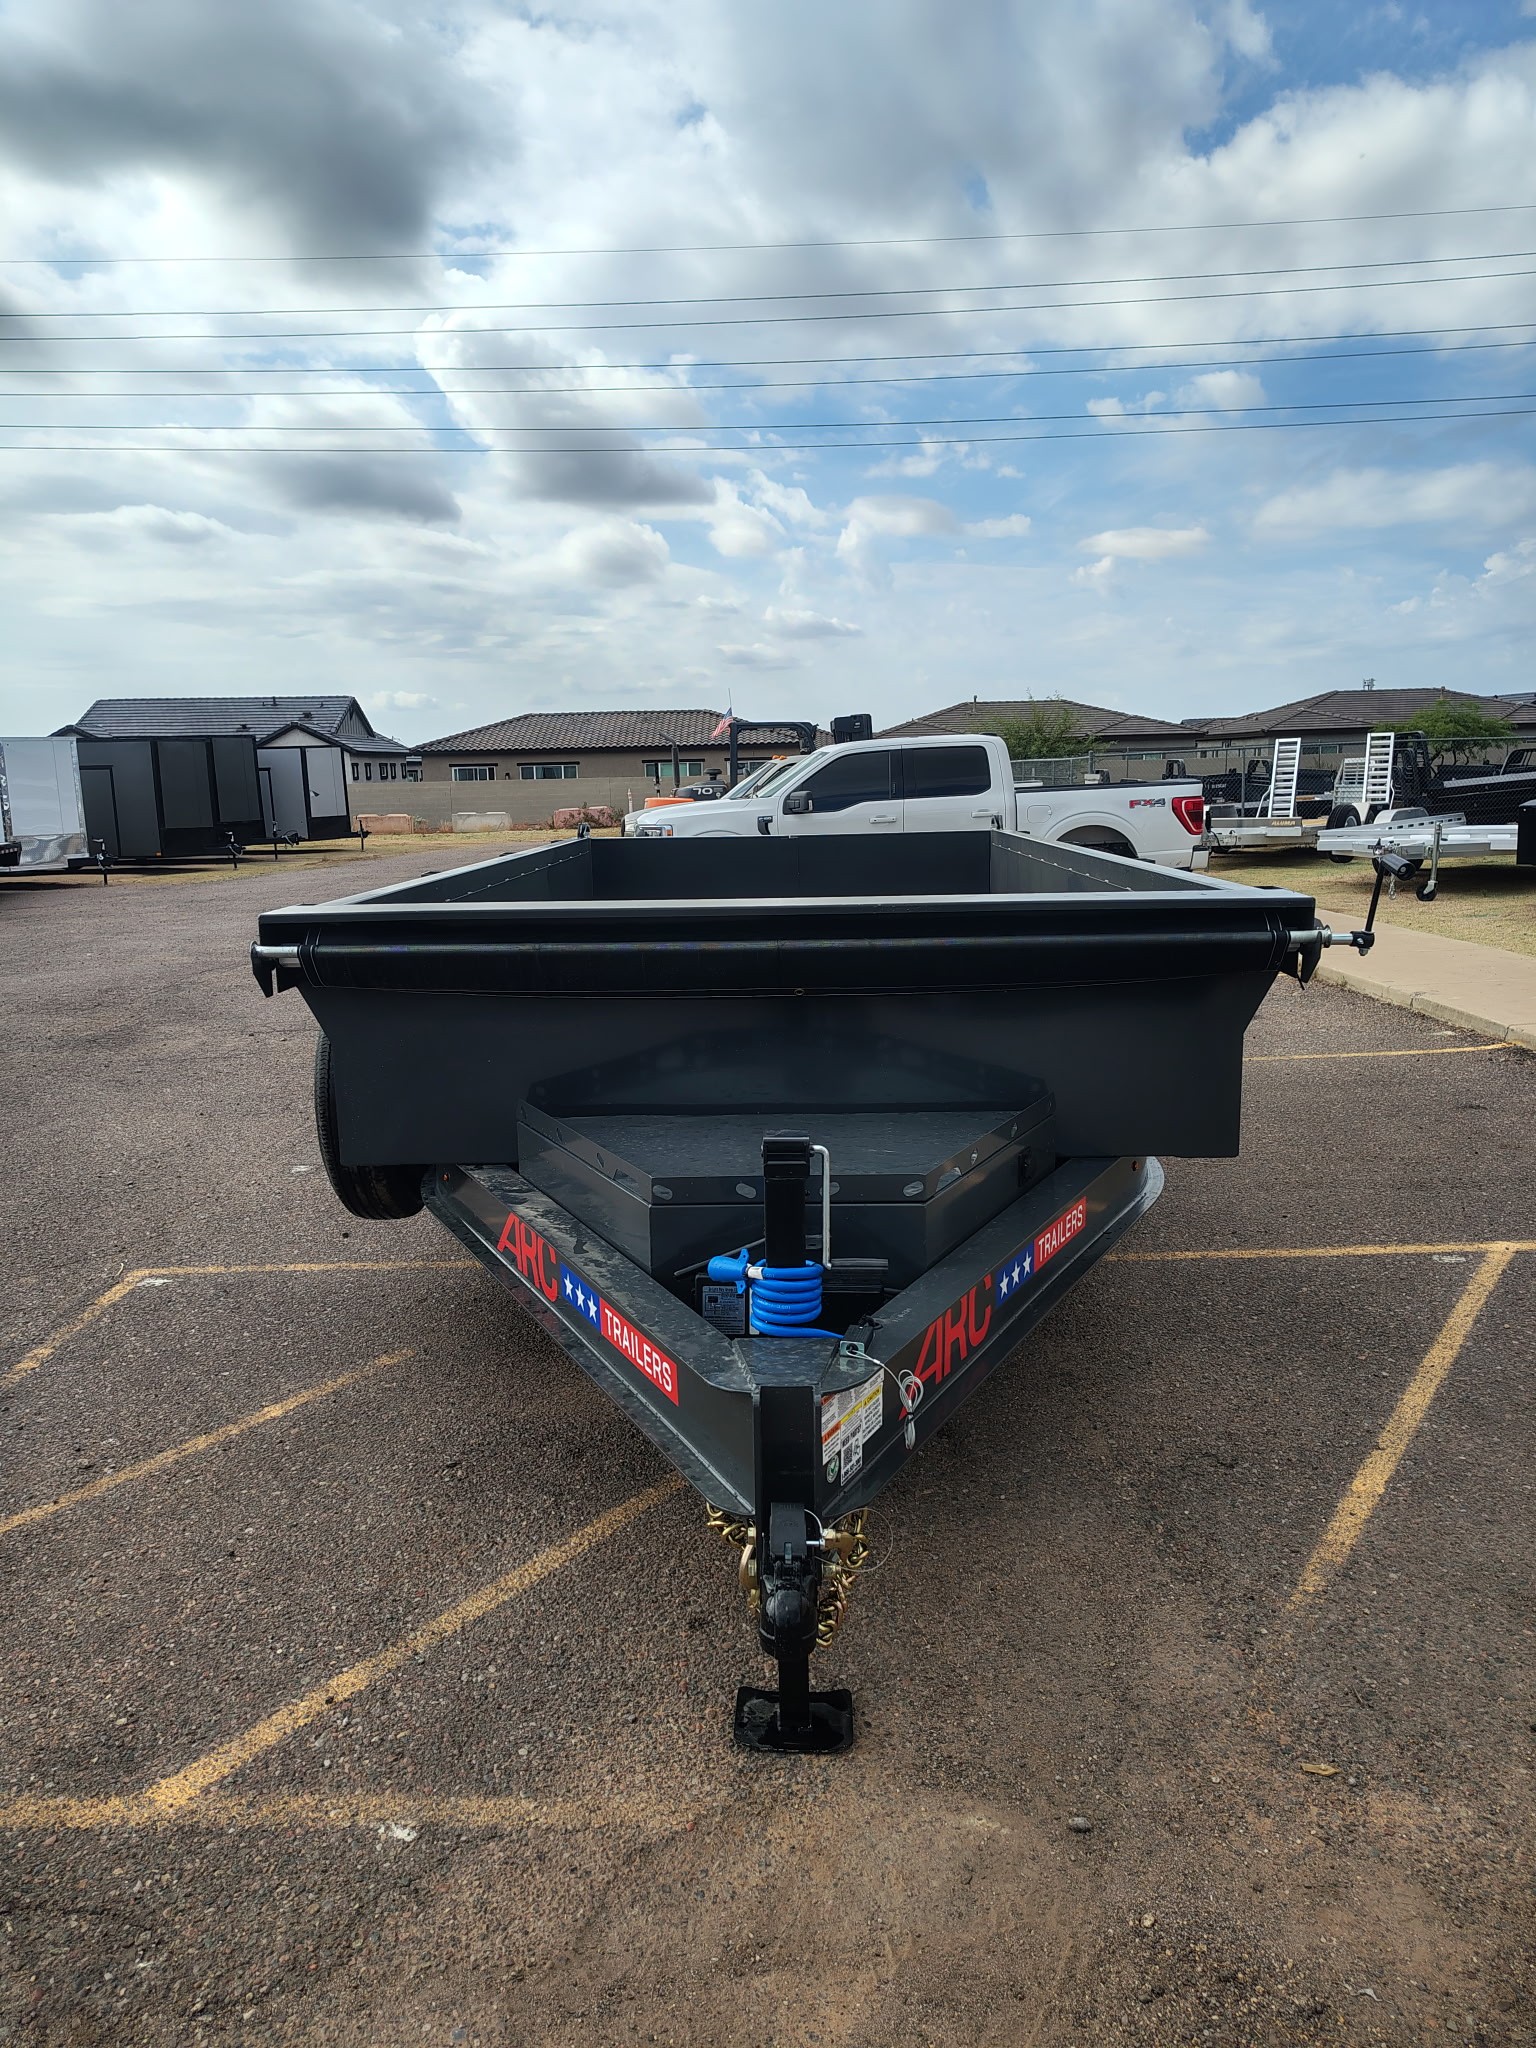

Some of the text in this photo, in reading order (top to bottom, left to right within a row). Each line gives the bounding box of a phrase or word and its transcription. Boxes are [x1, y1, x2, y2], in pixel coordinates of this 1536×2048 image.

[692, 787, 713, 796] 70
[1129, 798, 1166, 809] FX4
[497, 1212, 558, 1302] ARC
[605, 1308, 673, 1393] TRAILERS
[898, 1204, 1084, 1421] ARC TRAILERS
